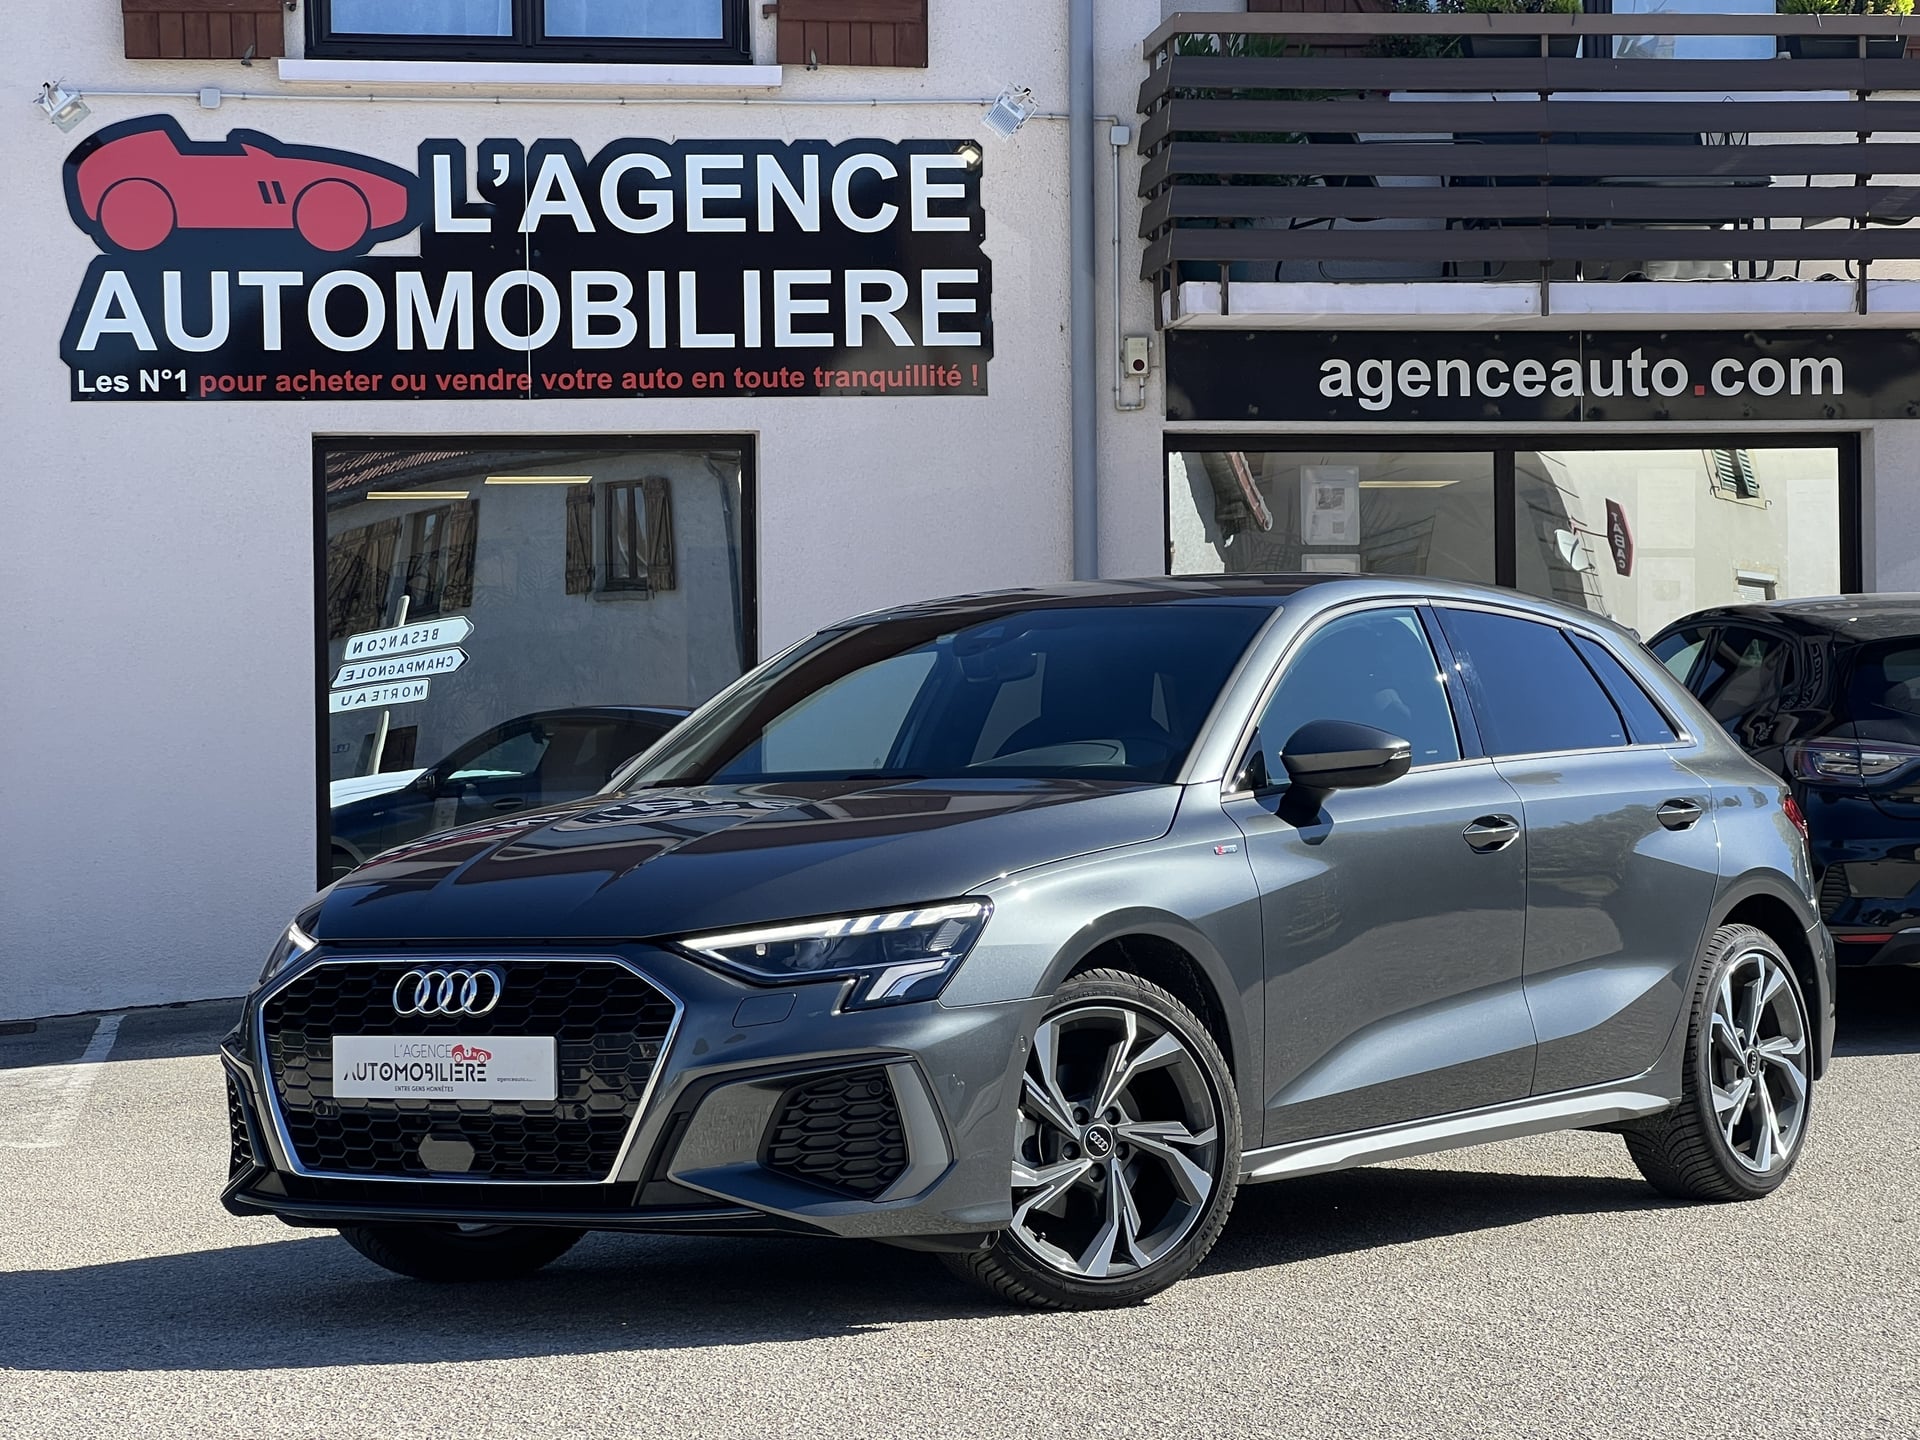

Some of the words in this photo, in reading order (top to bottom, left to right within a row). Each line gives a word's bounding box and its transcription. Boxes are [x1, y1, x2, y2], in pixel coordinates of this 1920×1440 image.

[76, 268, 982, 352] AUTOMOBILIERE
[77, 369, 130, 392] Les
[139, 369, 187, 393] N°1
[200, 371, 267, 398] pour
[275, 369, 383, 392] acheter
[391, 372, 428, 392] ou
[436, 368, 532, 392] vendre
[541, 369, 613, 391] votre
[621, 368, 684, 390] auto
[692, 370, 726, 389] en
[734, 366, 810, 388] toute
[813, 363, 963, 393] tranquillité
[970, 364, 979, 387] !
[1318, 346, 1845, 411] agenceauto.com
[343, 1062, 487, 1082] AUTOMOBILIERE
